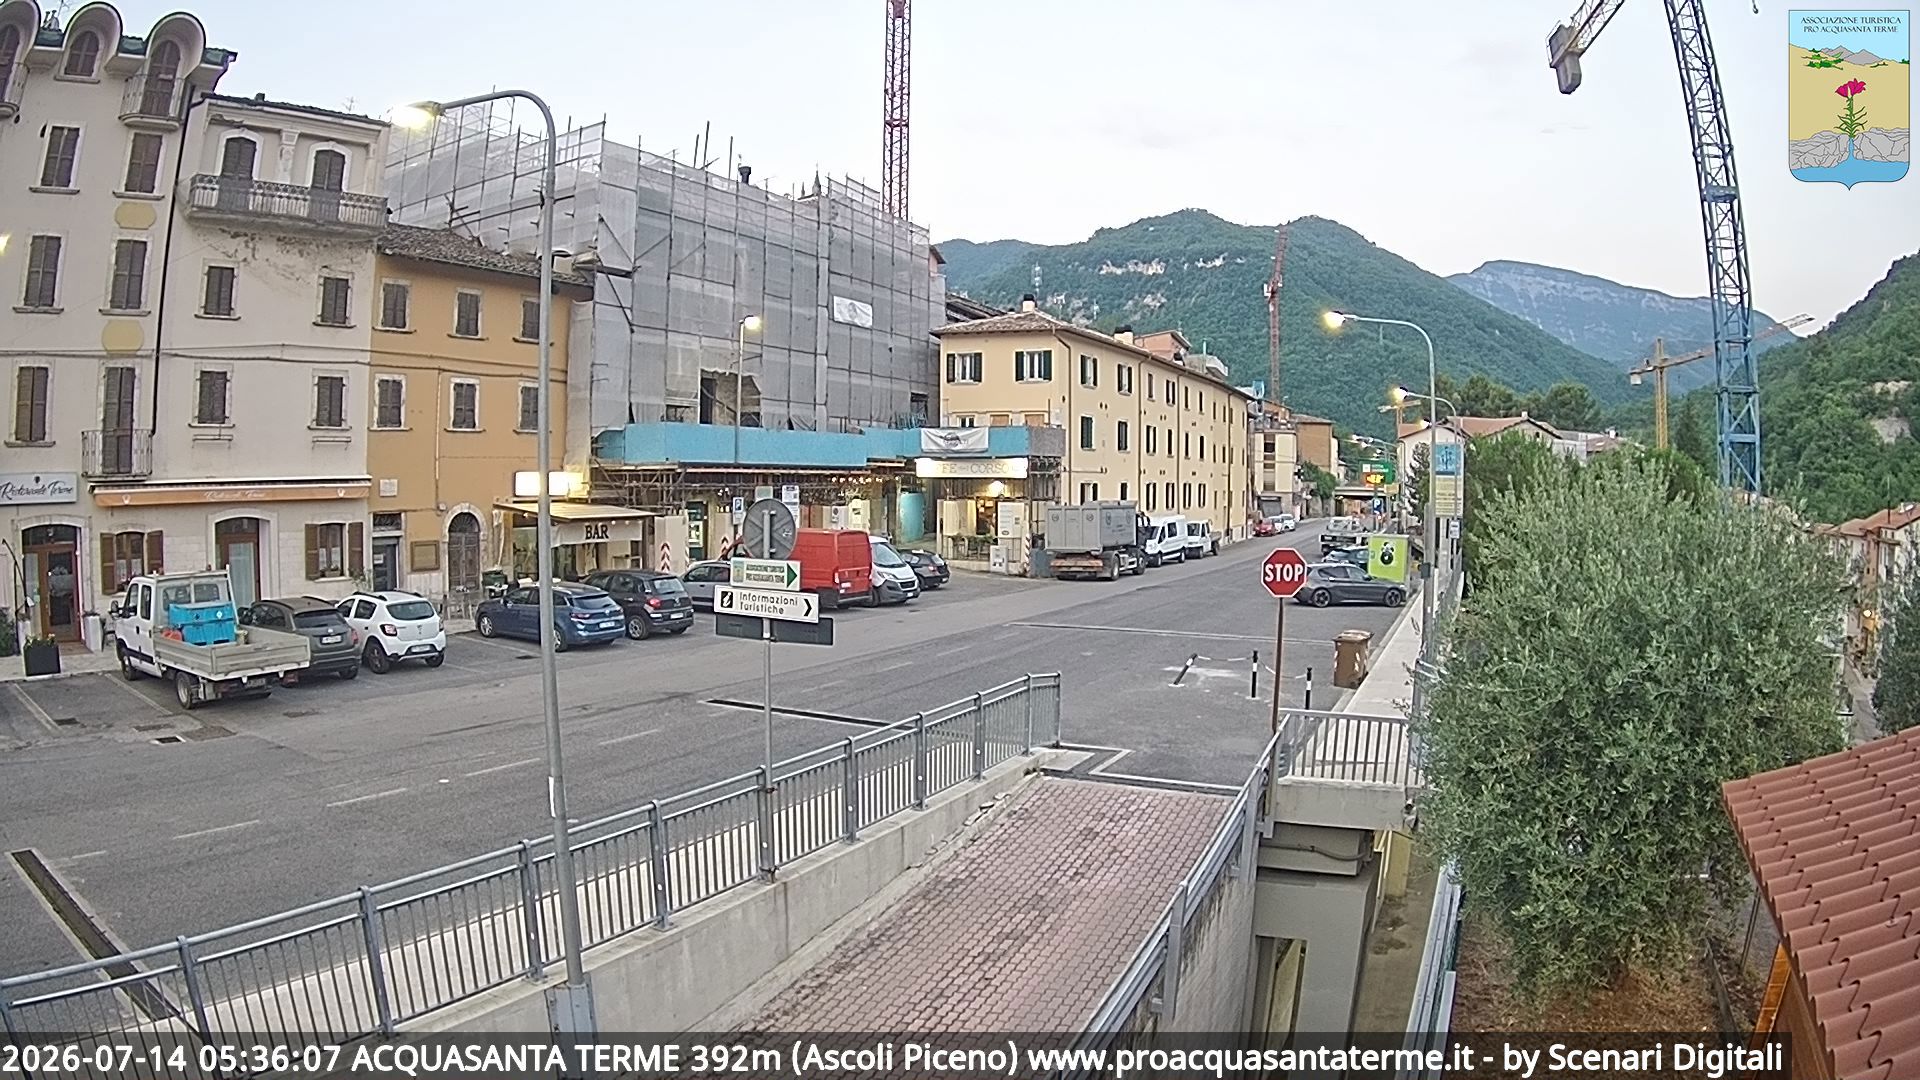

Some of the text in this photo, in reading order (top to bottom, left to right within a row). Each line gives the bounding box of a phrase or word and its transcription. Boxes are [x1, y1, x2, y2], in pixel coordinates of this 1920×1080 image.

[971, 463, 1009, 474] CORSO
[585, 524, 609, 540] BAR
[1265, 563, 1303, 582] STOP
[740, 592, 798, 606] Informazioni
[740, 602, 784, 615] Turistiche
